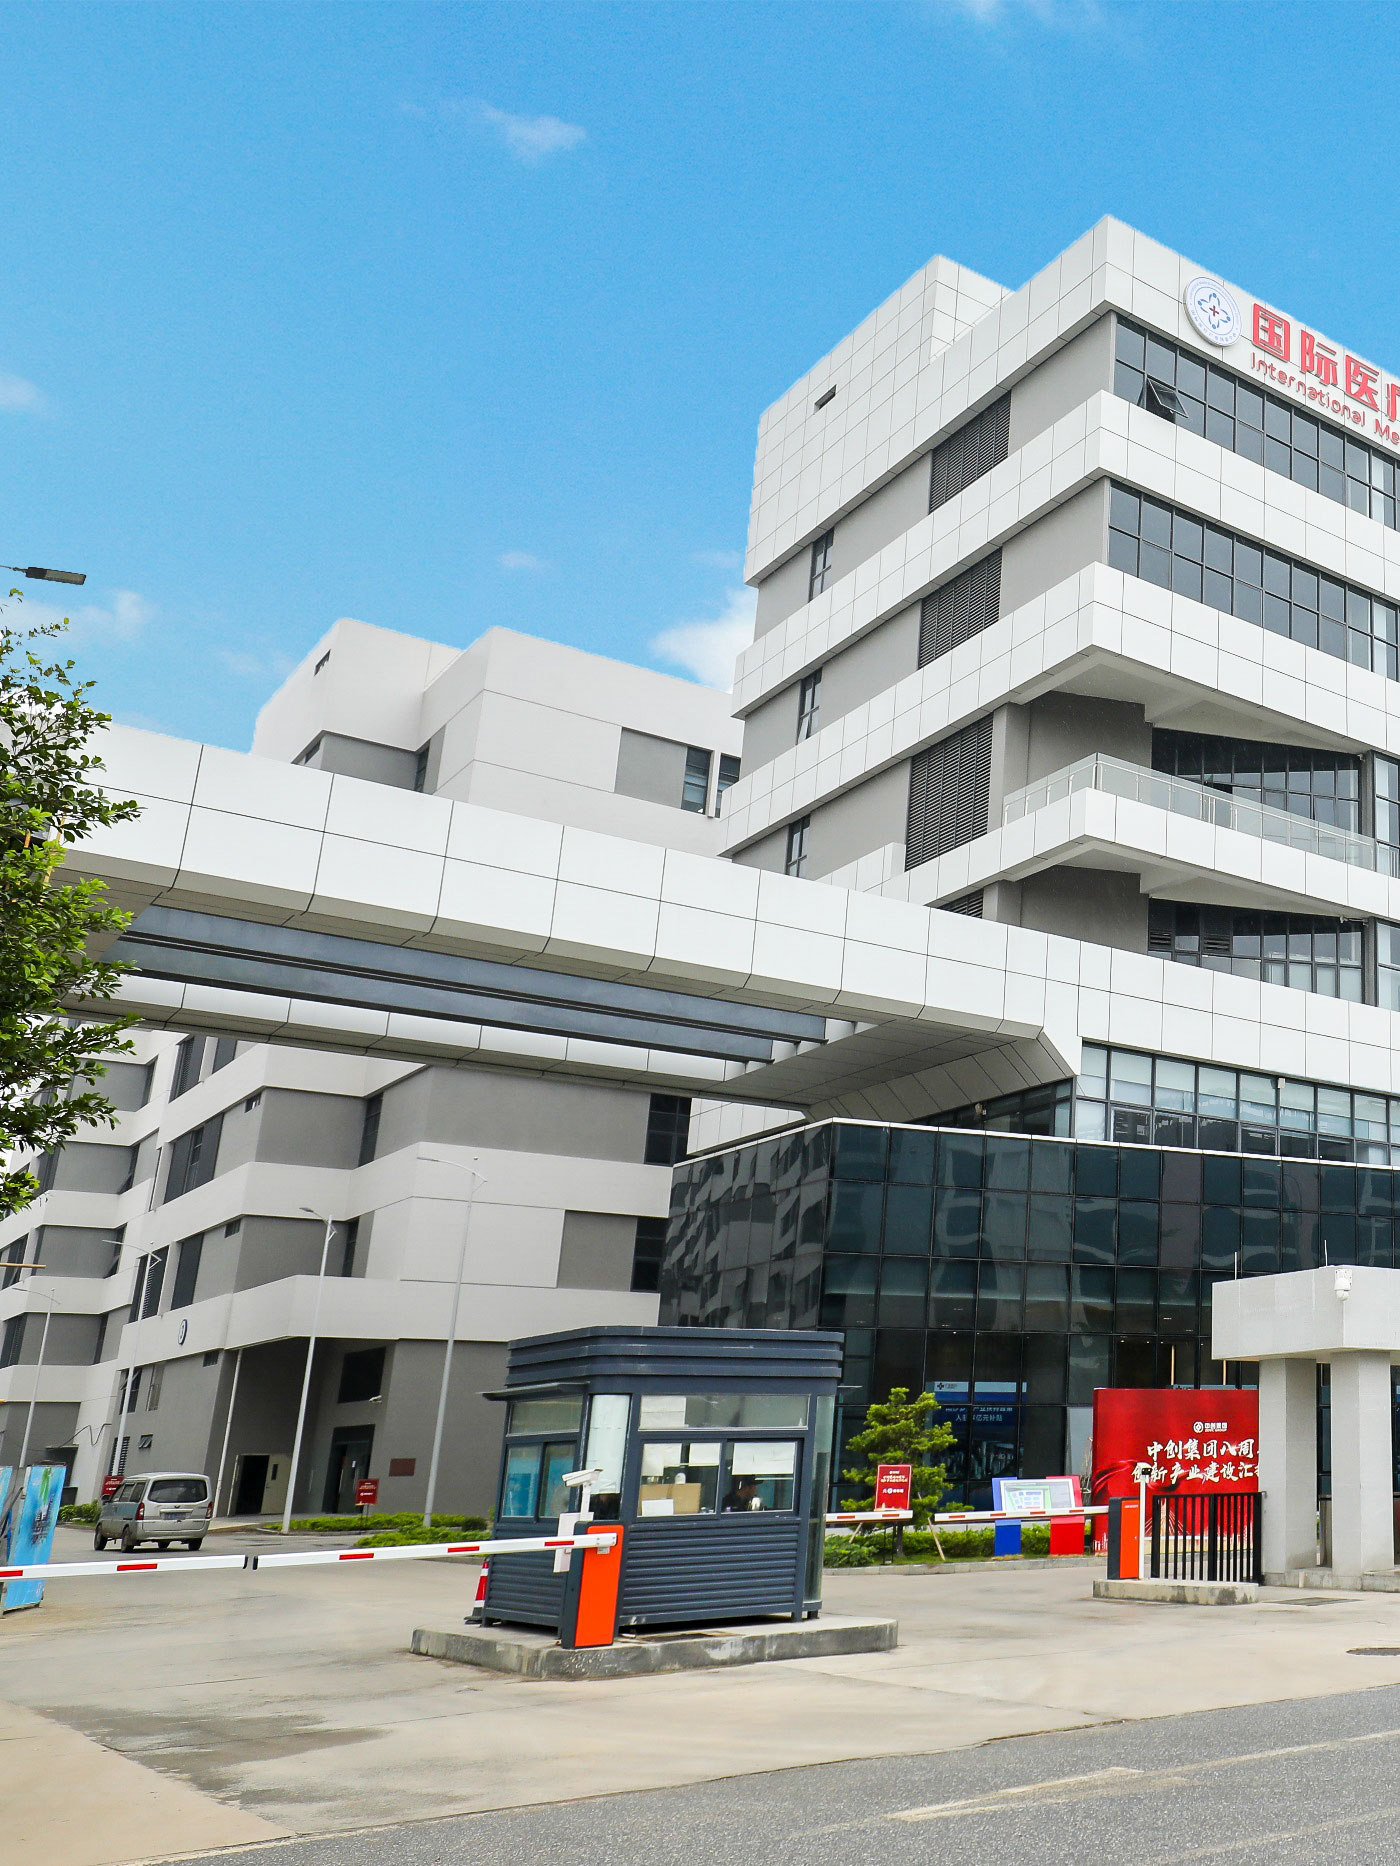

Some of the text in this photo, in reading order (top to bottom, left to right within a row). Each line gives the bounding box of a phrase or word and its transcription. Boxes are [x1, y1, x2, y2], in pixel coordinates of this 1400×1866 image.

[1250, 351, 1366, 428] International
[1147, 1438, 1259, 1461] 中创集团八周
